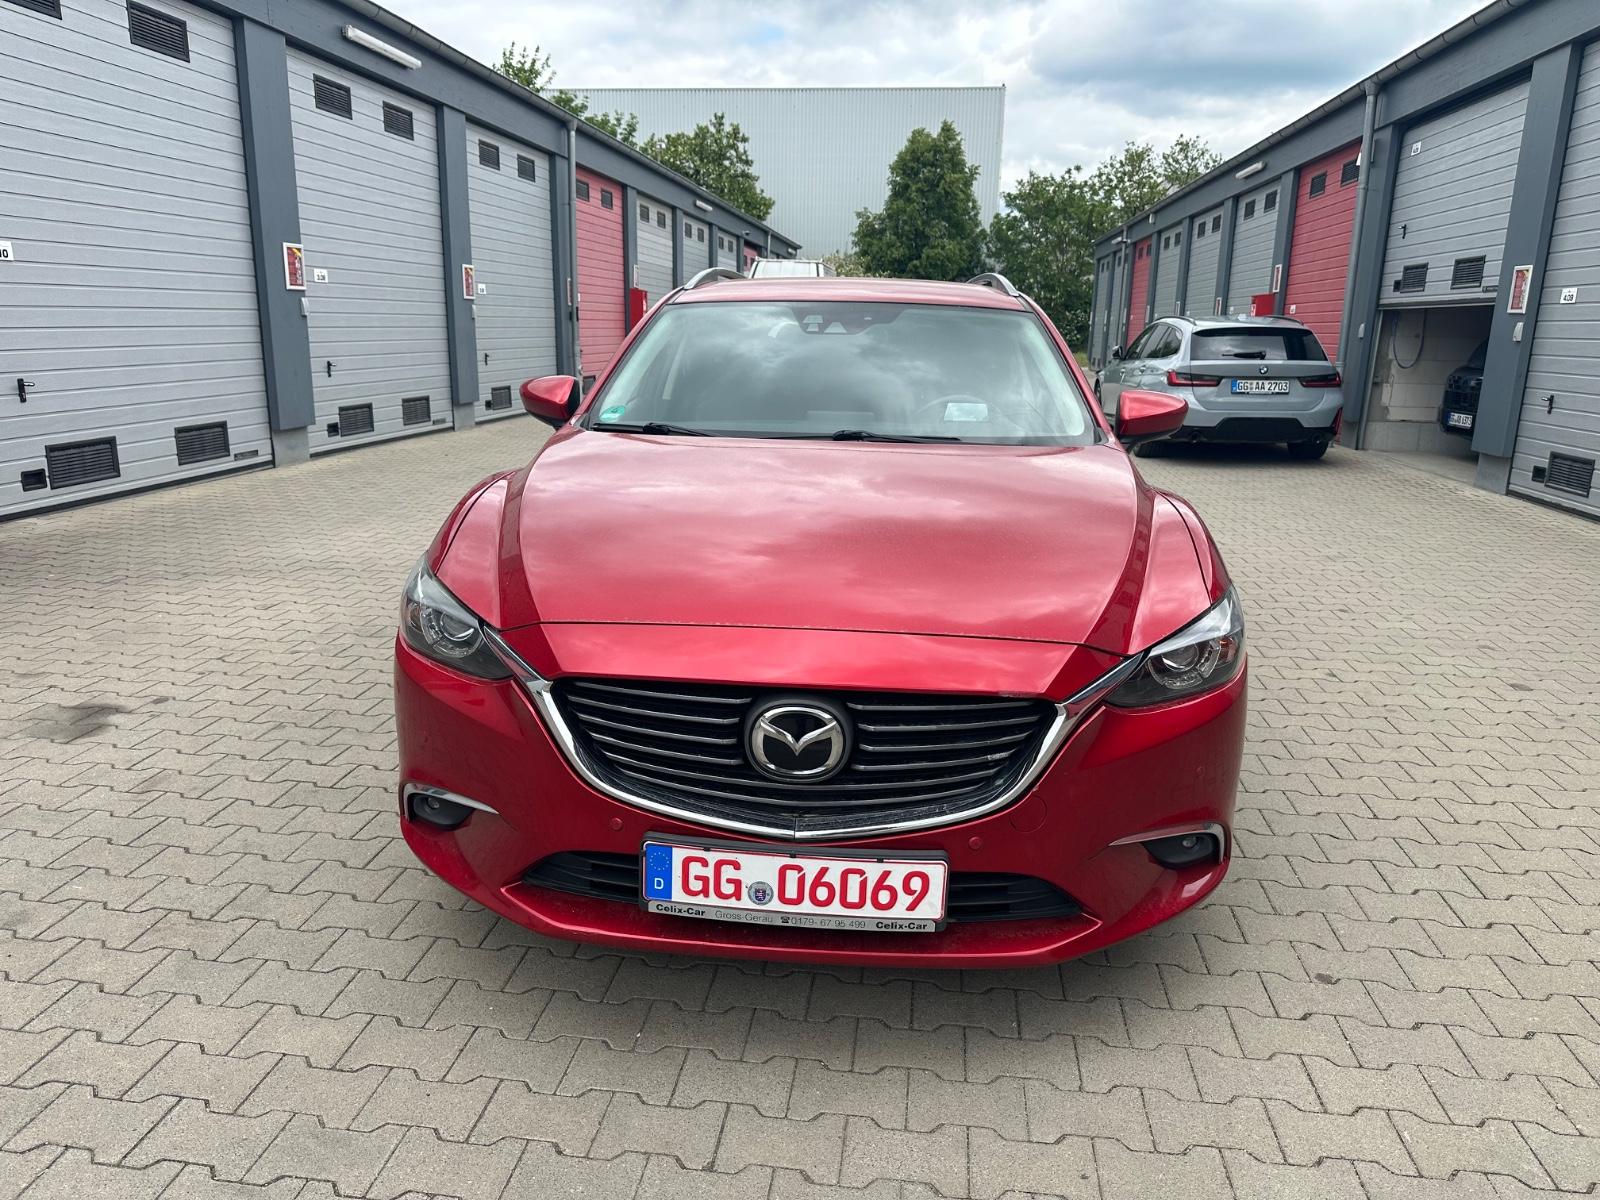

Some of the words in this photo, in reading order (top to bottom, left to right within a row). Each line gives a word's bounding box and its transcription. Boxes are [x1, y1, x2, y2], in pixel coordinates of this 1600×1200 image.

[1237, 381, 1249, 391] GG
[1254, 381, 1266, 391] AA
[1267, 381, 1288, 391] 2703
[654, 877, 664, 889] D
[681, 855, 743, 901] GG
[777, 863, 931, 912] 06069
[656, 903, 706, 917] Celix-Car
[848, 920, 867, 930] 499
[875, 920, 929, 931] Celix-Car
